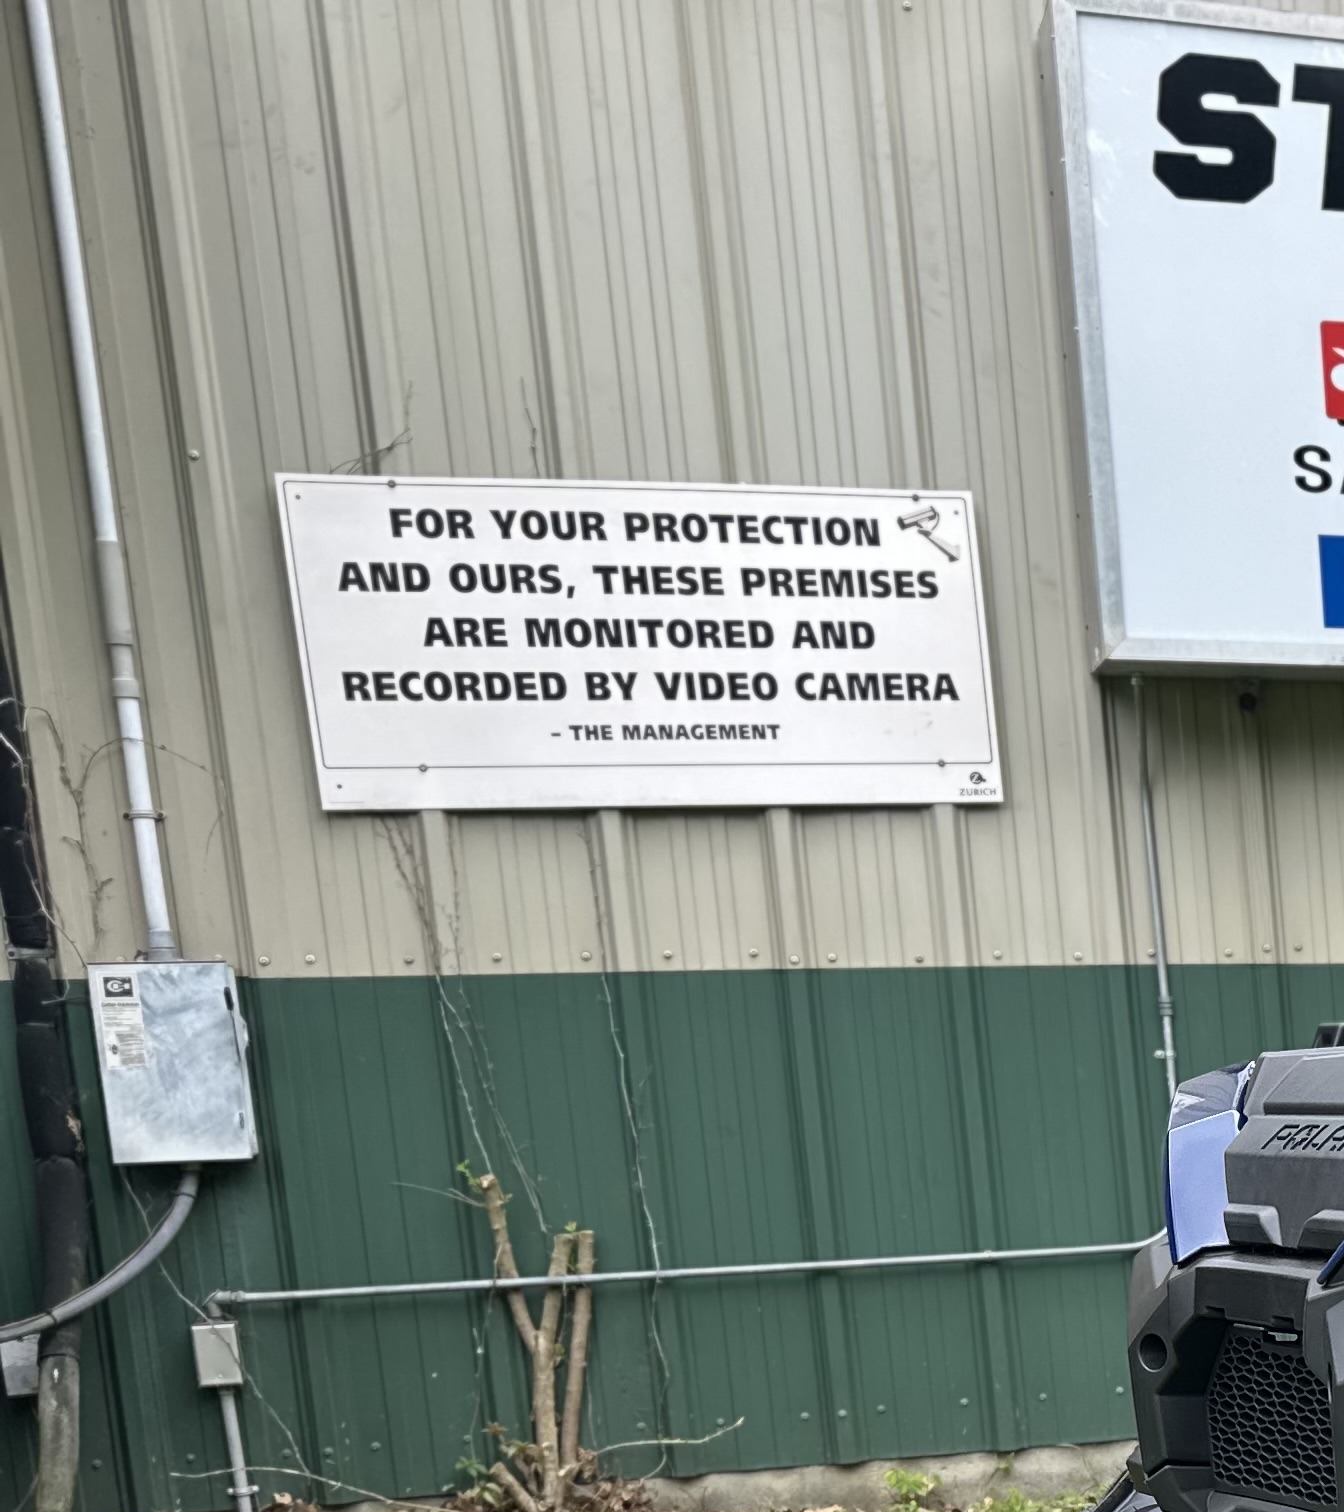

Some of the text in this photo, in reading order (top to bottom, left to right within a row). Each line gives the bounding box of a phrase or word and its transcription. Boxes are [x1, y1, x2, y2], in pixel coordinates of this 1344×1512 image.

[389, 508, 881, 547] FOR YOUR PROTECTION
[338, 561, 939, 600] AND OURS, THESE PREMISES
[423, 617, 875, 650] ARE MONITORED AND
[341, 671, 960, 702] RECORDED BY VIDEO CAMERA
[568, 725, 613, 741] THE
[622, 724, 780, 741] MANAGEMENT
